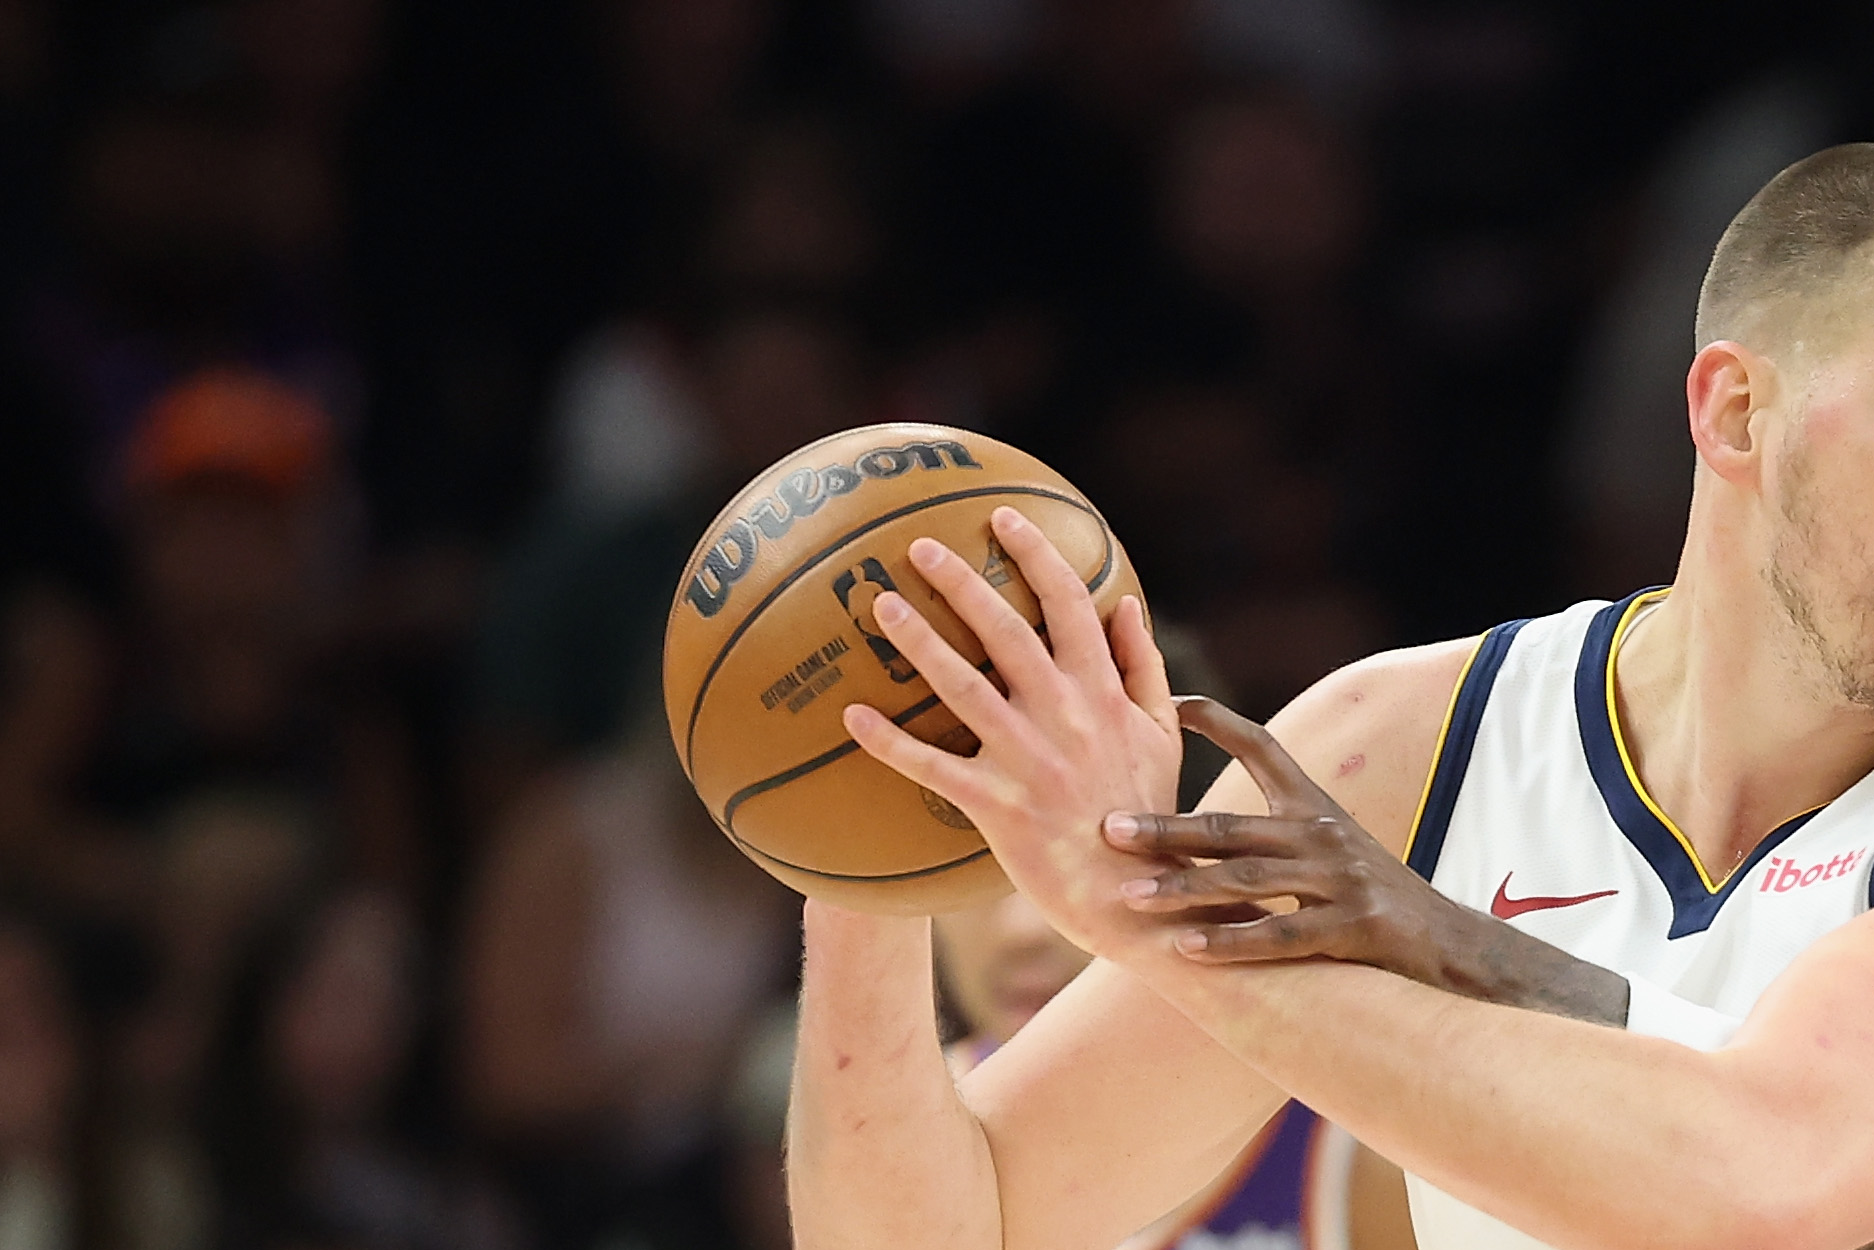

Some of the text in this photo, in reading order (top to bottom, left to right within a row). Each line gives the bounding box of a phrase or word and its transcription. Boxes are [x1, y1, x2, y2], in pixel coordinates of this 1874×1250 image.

[686, 440, 983, 619] Wilson
[760, 672, 802, 710] OFFICIAL
[796, 651, 826, 681] GAME
[822, 636, 850, 662] BALL
